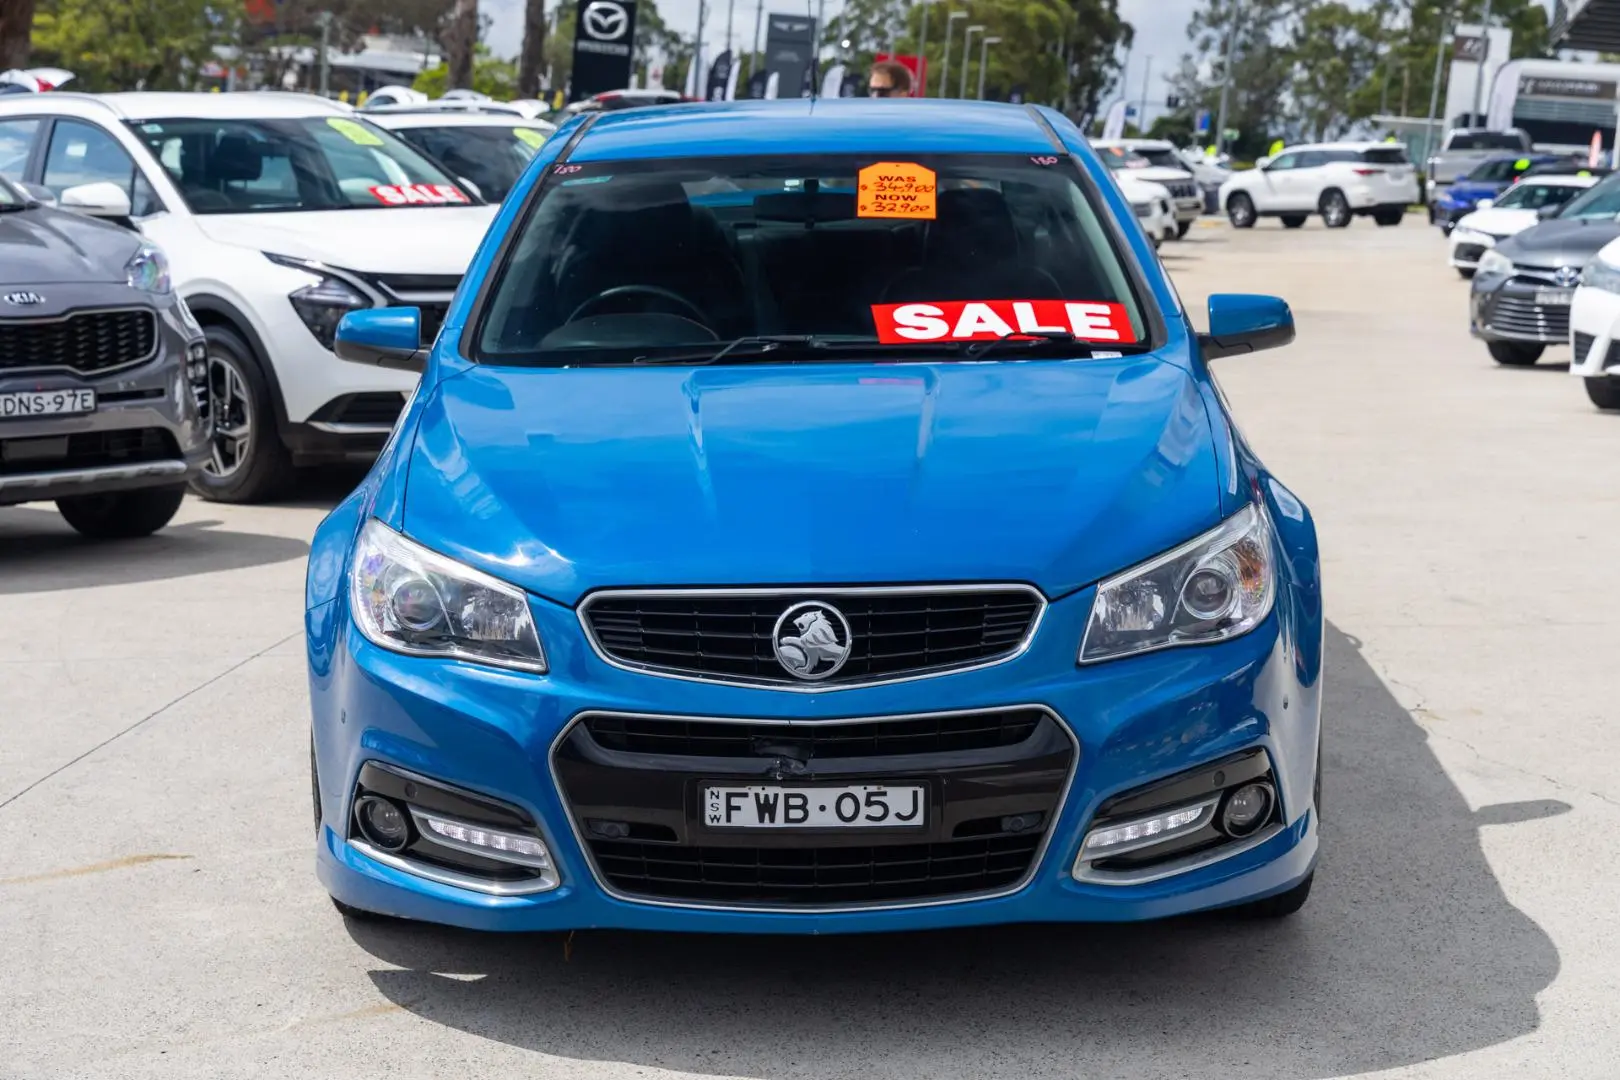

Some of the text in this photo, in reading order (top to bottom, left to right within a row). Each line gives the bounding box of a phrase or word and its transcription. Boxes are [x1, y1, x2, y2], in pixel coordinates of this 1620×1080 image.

[878, 175, 917, 183] WAS
[375, 185, 465, 205] SALE
[11, 291, 41, 304] KIA
[892, 302, 1120, 340] SALE
